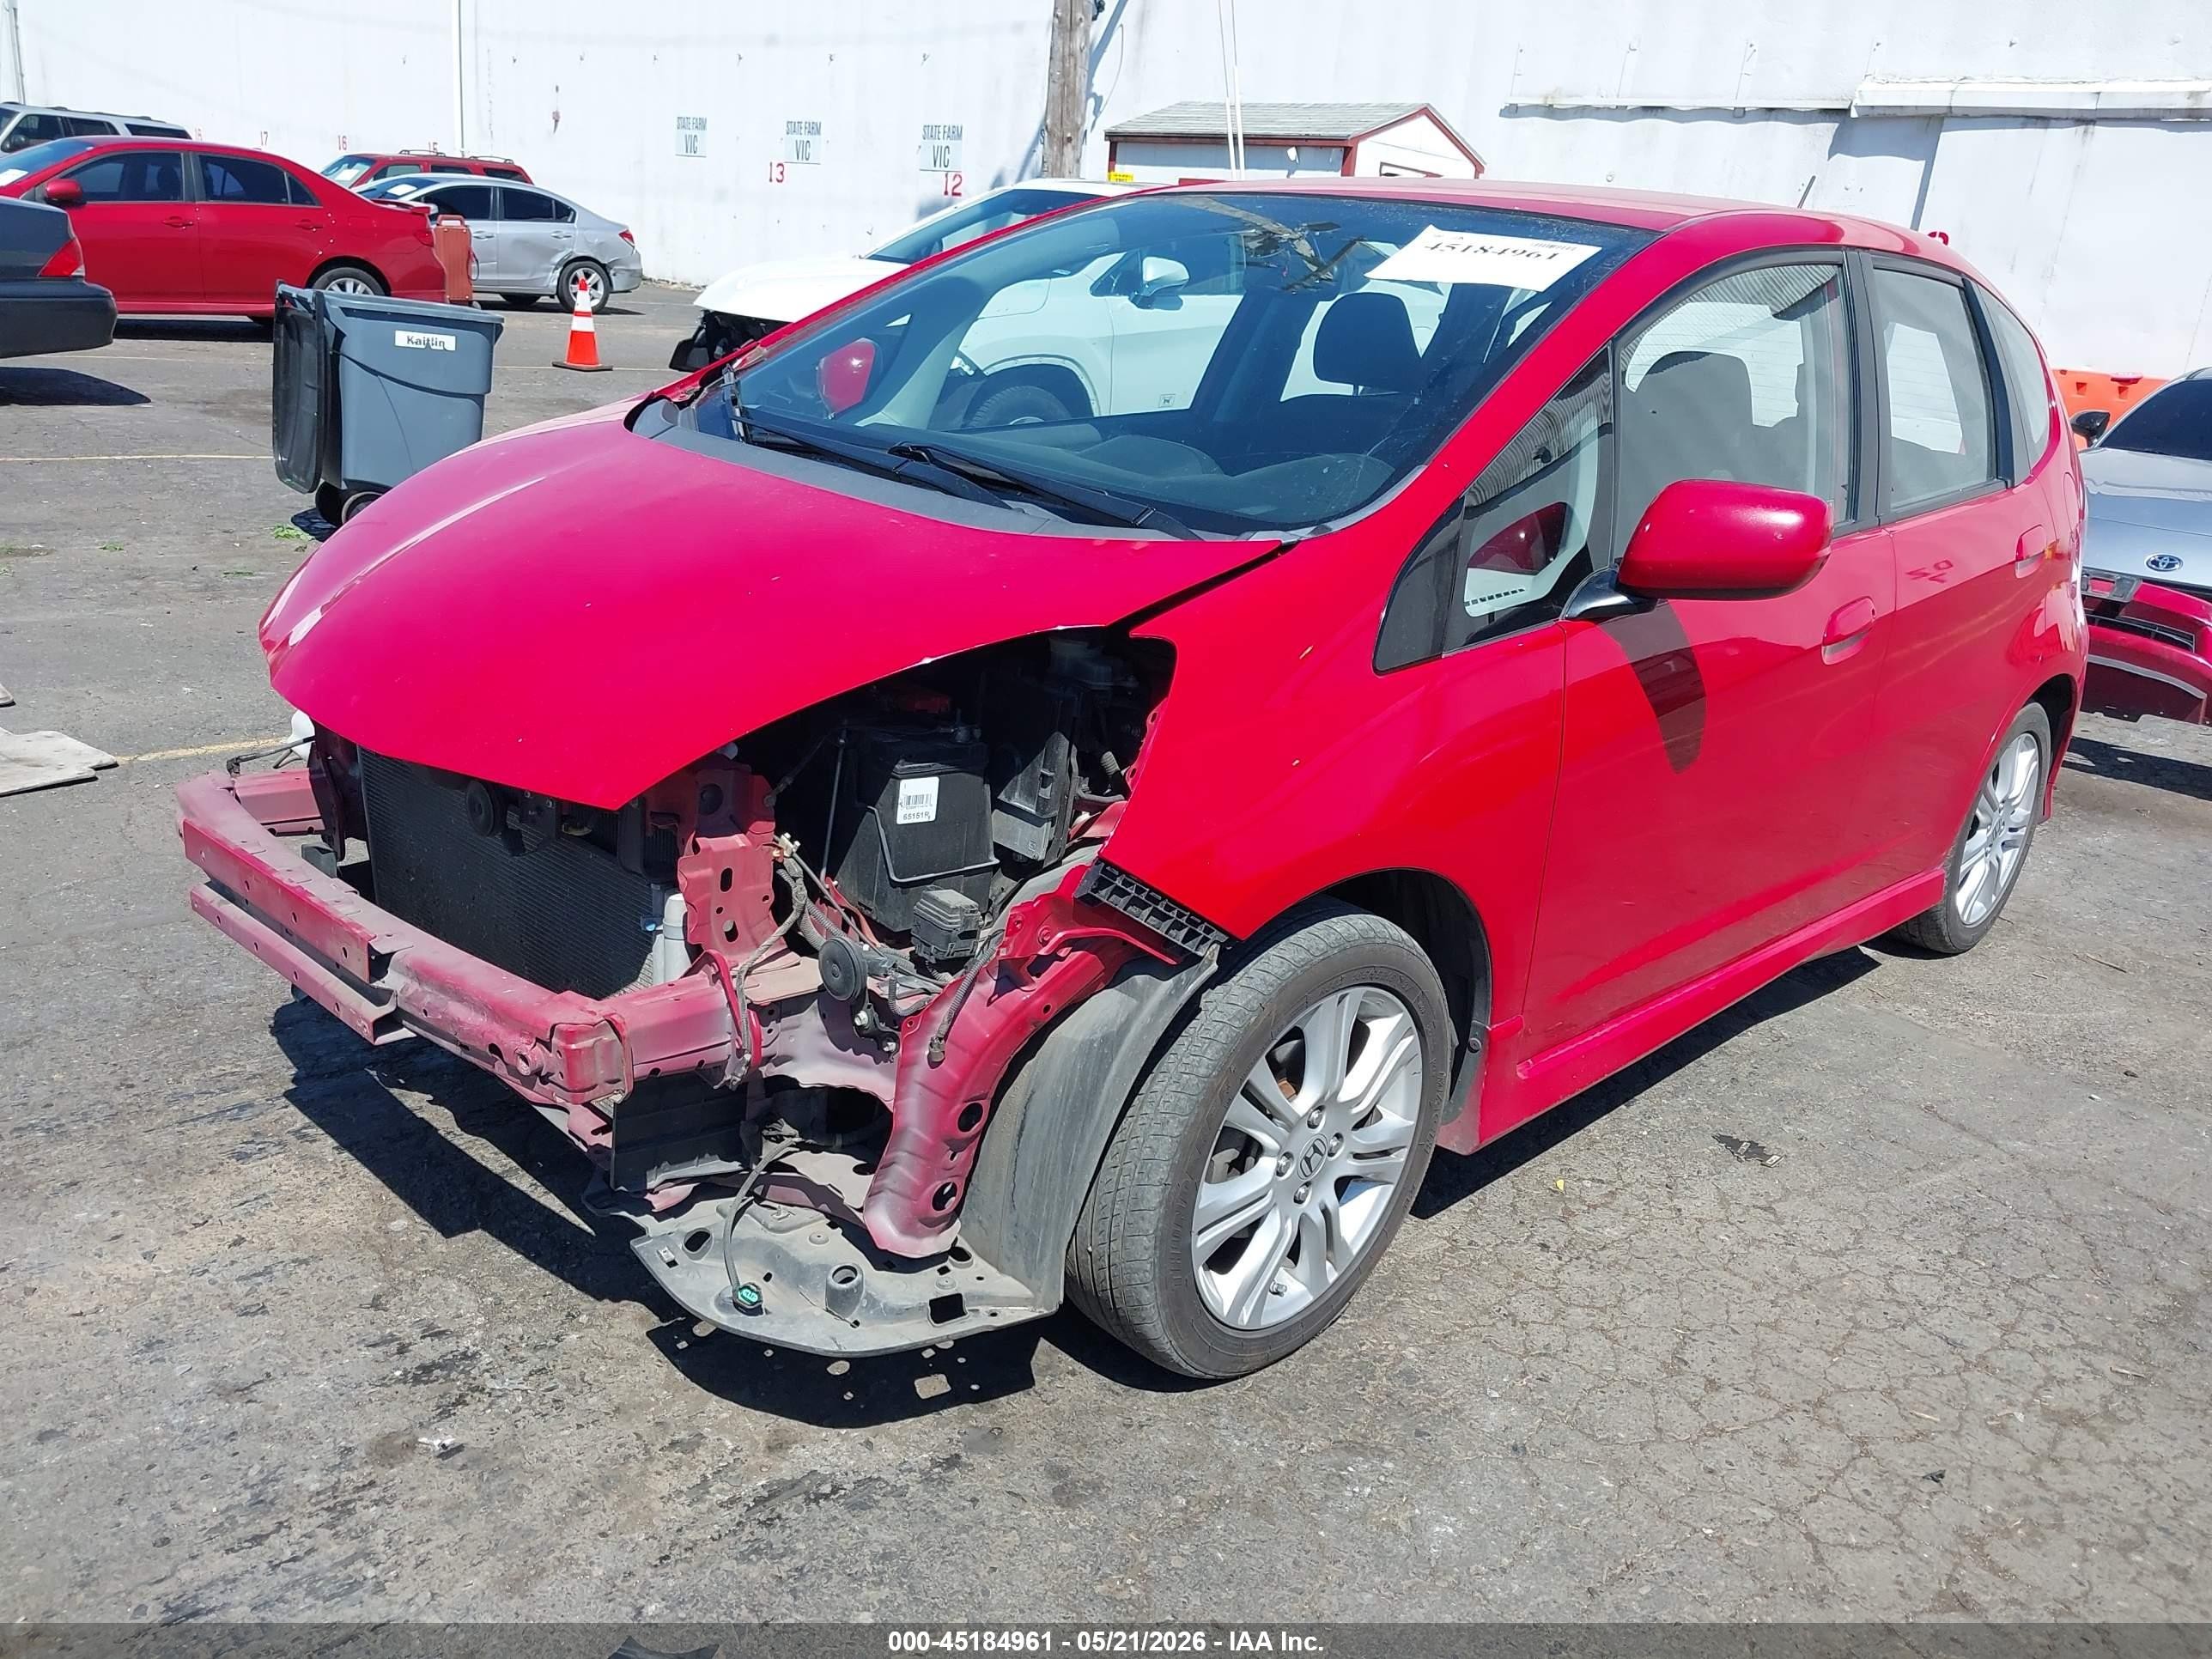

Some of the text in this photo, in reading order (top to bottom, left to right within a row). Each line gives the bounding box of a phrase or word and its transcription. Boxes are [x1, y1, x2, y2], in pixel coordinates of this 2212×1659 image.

[676, 116, 708, 131] STATE FARM
[786, 120, 822, 137] STATE FARM
[260, 131, 269, 146] 17
[922, 125, 963, 141] STATE FARM
[337, 135, 348, 150] 16
[684, 134, 698, 154] VIC
[795, 139, 811, 161] VIC
[933, 144, 951, 168] VIC
[769, 161, 785, 183] 13
[944, 172, 963, 197] 12
[406, 335, 446, 348] Kaitlin
